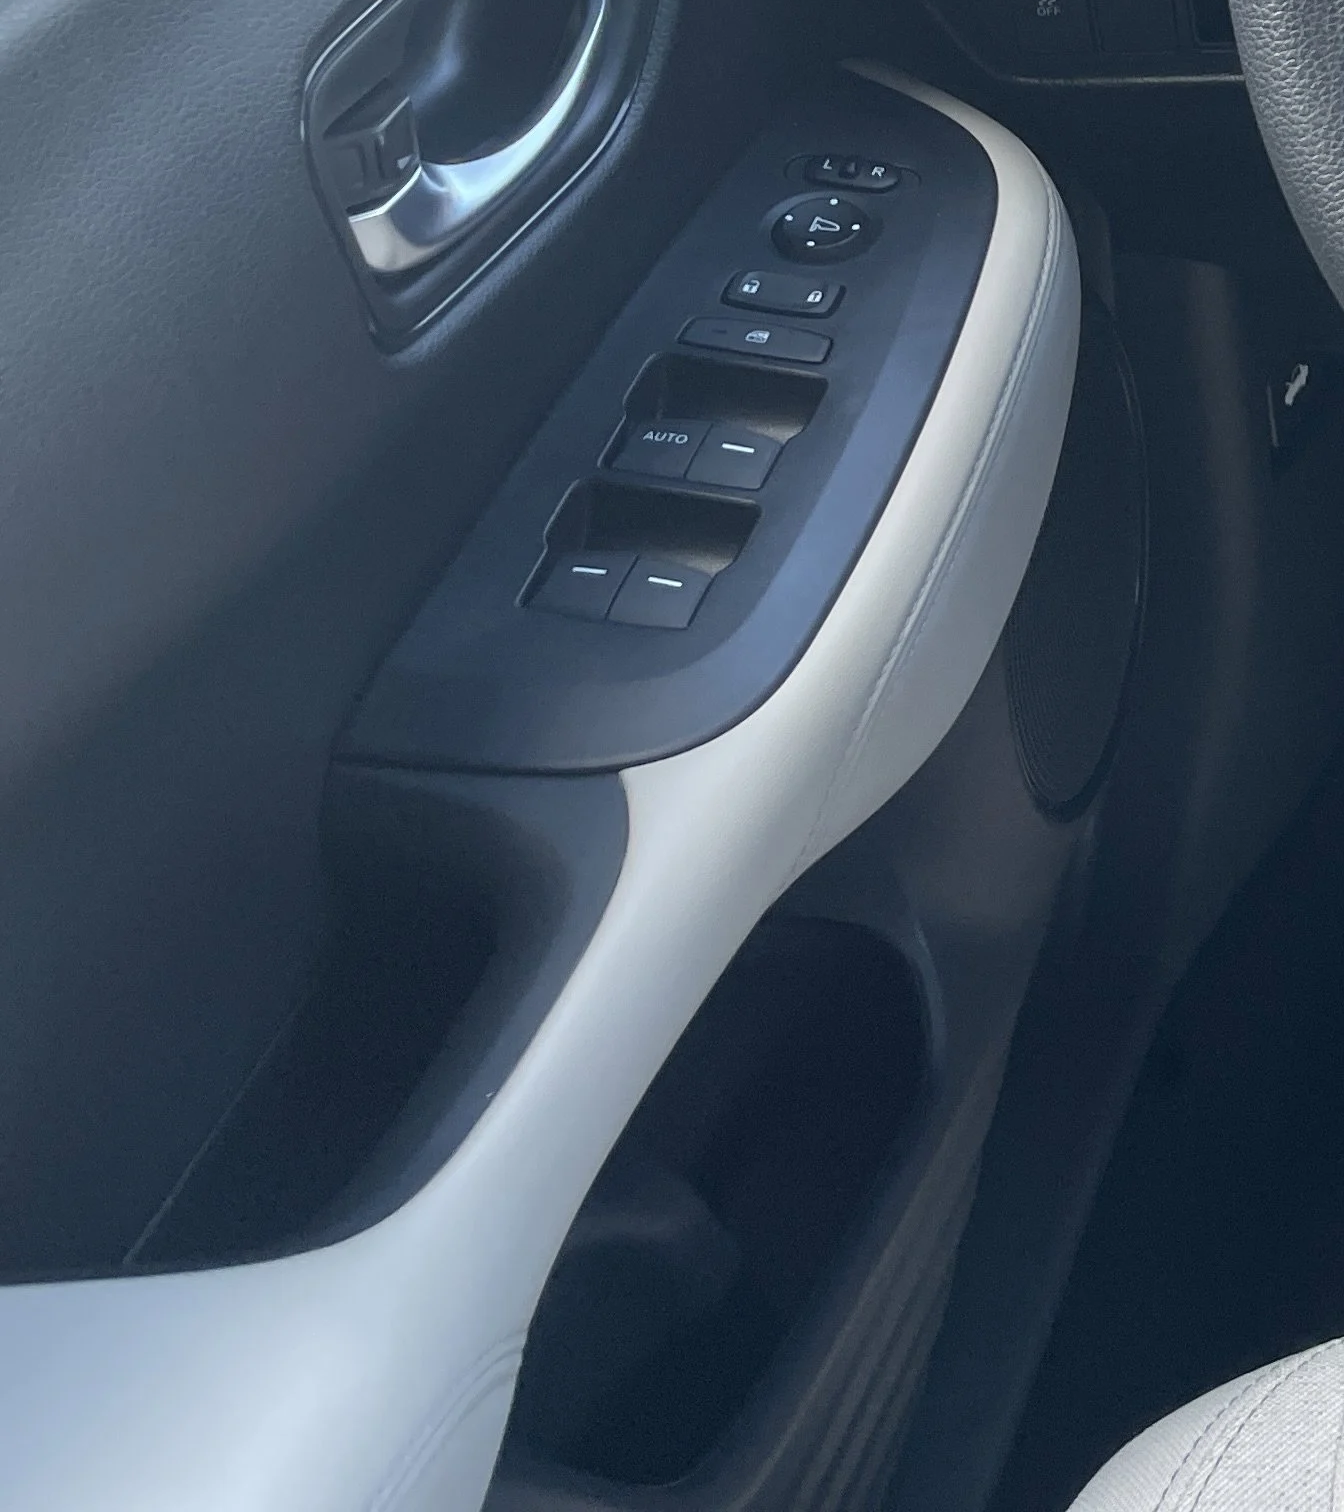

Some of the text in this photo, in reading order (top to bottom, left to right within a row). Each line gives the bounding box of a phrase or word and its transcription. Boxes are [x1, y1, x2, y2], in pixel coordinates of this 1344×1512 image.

[822, 158, 834, 170] L
[870, 166, 887, 178] R
[643, 430, 688, 445] AUTO
